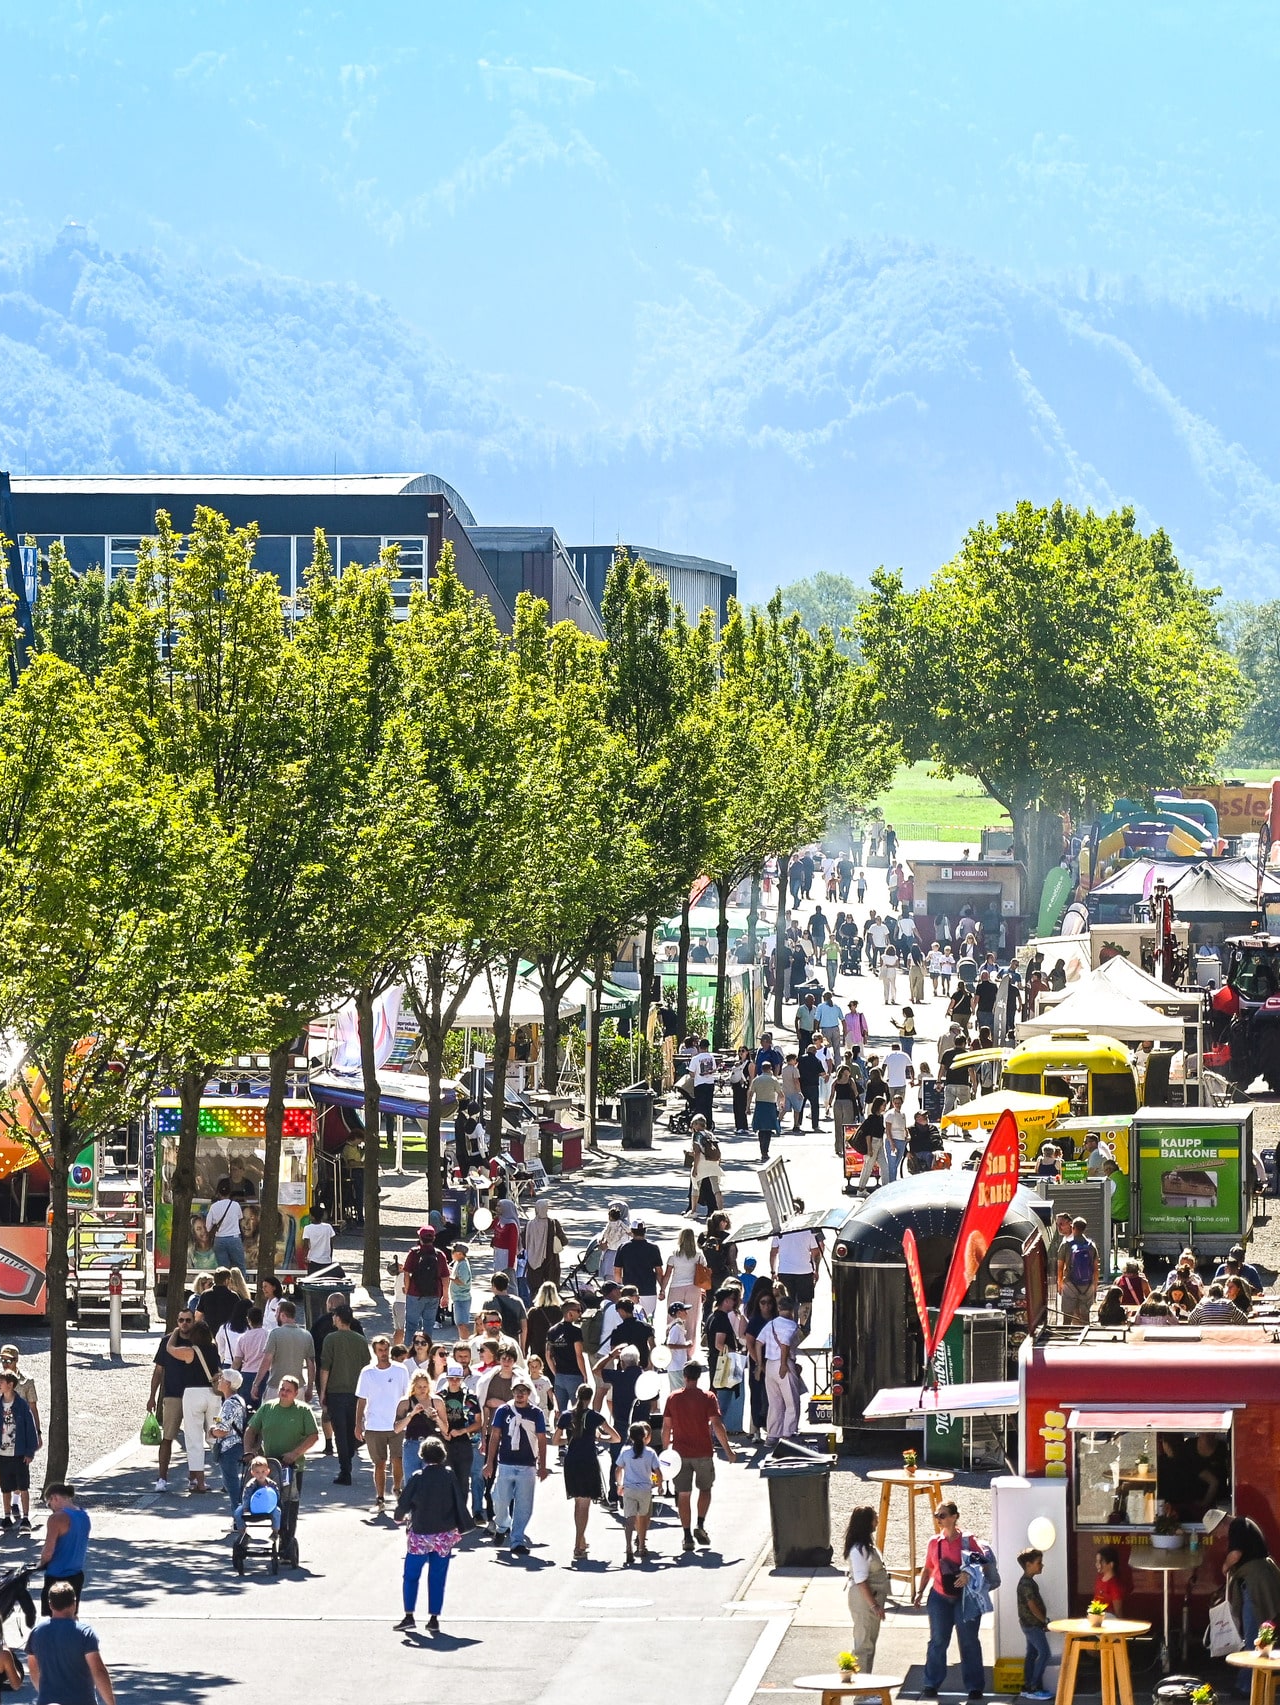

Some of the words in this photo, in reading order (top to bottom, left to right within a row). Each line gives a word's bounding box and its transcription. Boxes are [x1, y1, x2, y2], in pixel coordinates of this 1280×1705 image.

[1024, 1115, 1046, 1123] KAUPP
[1161, 1138, 1202, 1148] KAUPP
[1161, 1149, 1218, 1158] BALKONE
[815, 1410, 826, 1419] VO
[1039, 1411, 1067, 1477] nuts
